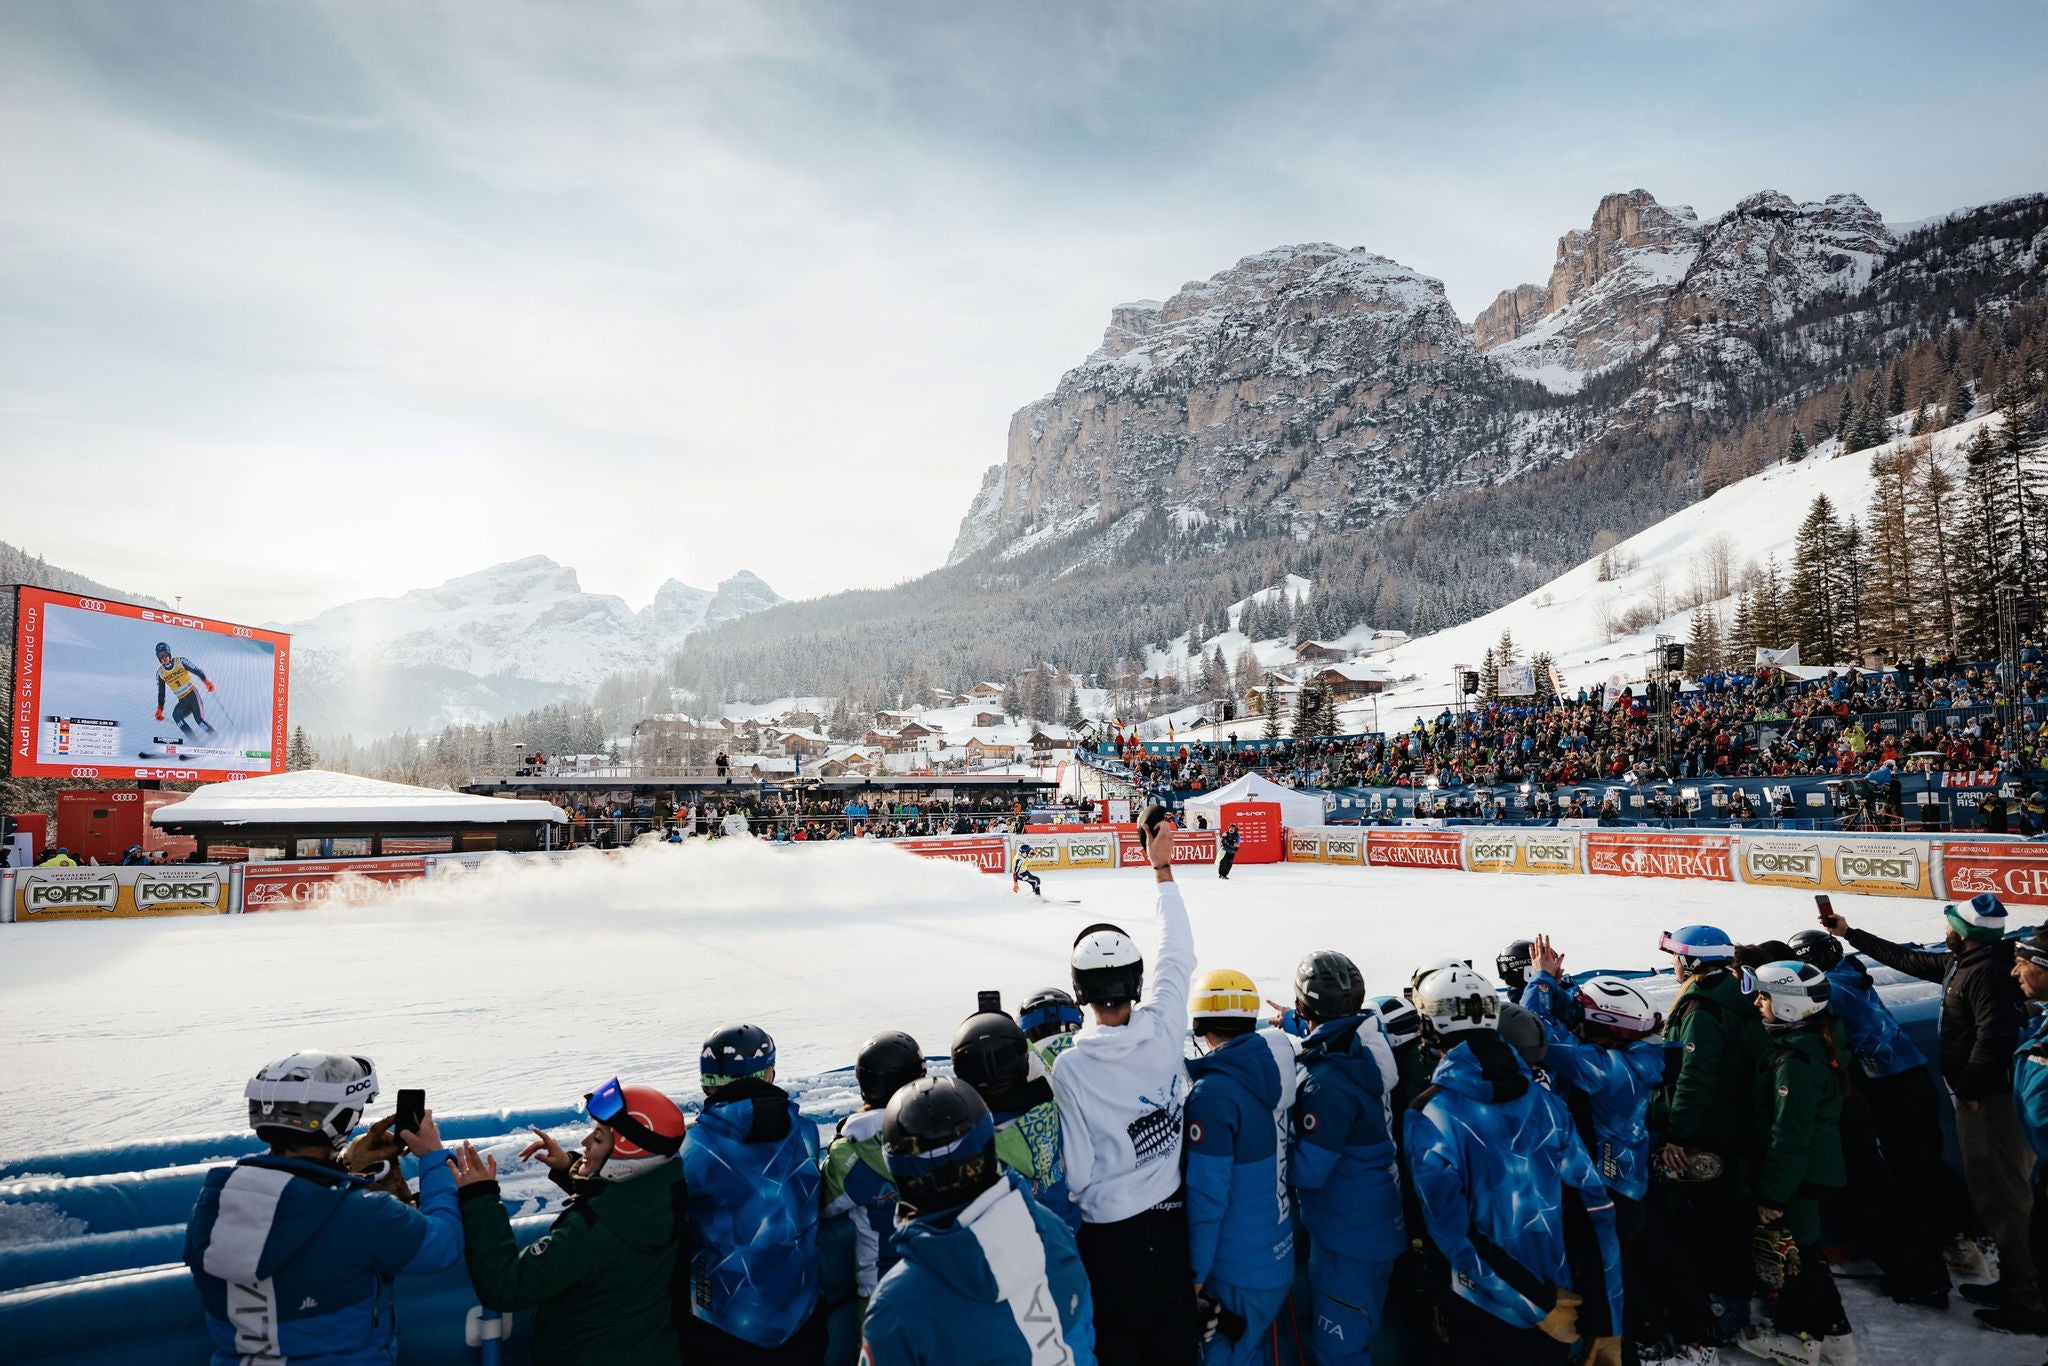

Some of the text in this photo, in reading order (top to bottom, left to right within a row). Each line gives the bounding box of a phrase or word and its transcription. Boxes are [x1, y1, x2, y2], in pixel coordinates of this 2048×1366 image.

[142, 611, 204, 629] e-tron
[20, 608, 37, 757] Audi FIS Ski World Cup
[135, 768, 198, 779] e-tron
[1071, 845, 1106, 856] FORST
[1292, 840, 1318, 852] FORST
[1328, 841, 1356, 853] FORST
[1475, 844, 1512, 858] FORST
[1530, 845, 1570, 860] FORST
[1388, 846, 1459, 865] GENERALI
[1753, 854, 1815, 873] FORST
[1622, 852, 1728, 877] GENERALI
[1842, 858, 1912, 878] FORST
[33, 885, 112, 903] FORST
[142, 883, 214, 900] FORST
[346, 1080, 371, 1096] POC
[1318, 1314, 1344, 1341] ITA
[1769, 1348, 1809, 1364] HEAD
